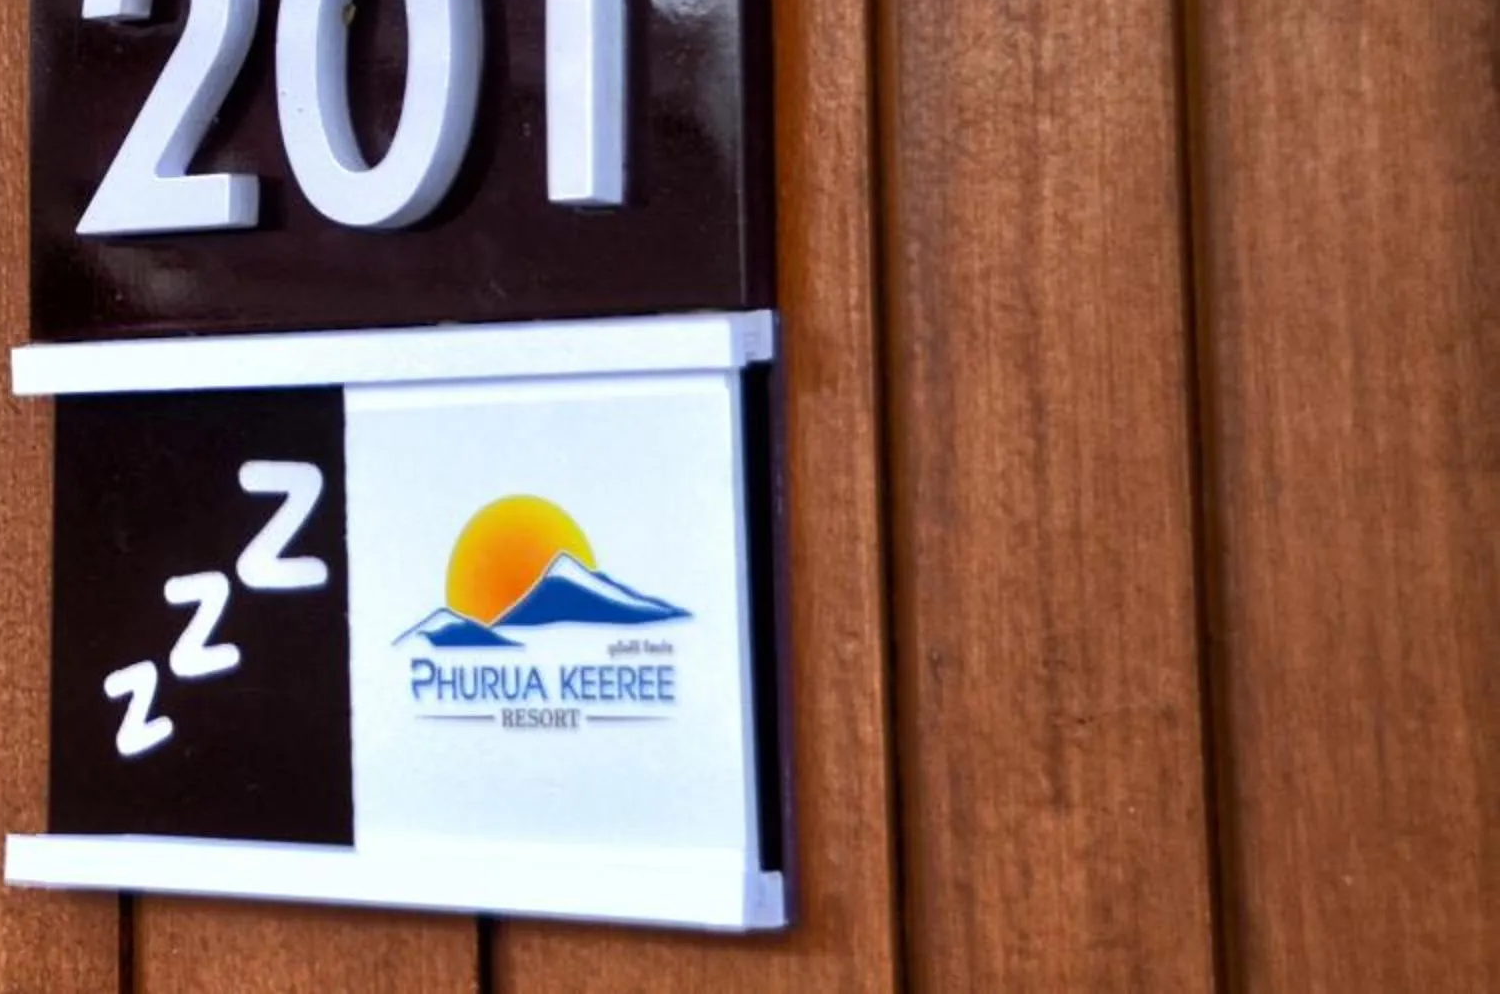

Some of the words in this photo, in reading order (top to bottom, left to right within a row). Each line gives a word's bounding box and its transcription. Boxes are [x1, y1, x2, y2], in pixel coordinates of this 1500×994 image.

[411, 658, 548, 701] PHURUA
[561, 665, 675, 701] KEEREE
[502, 708, 581, 728] RESORT
